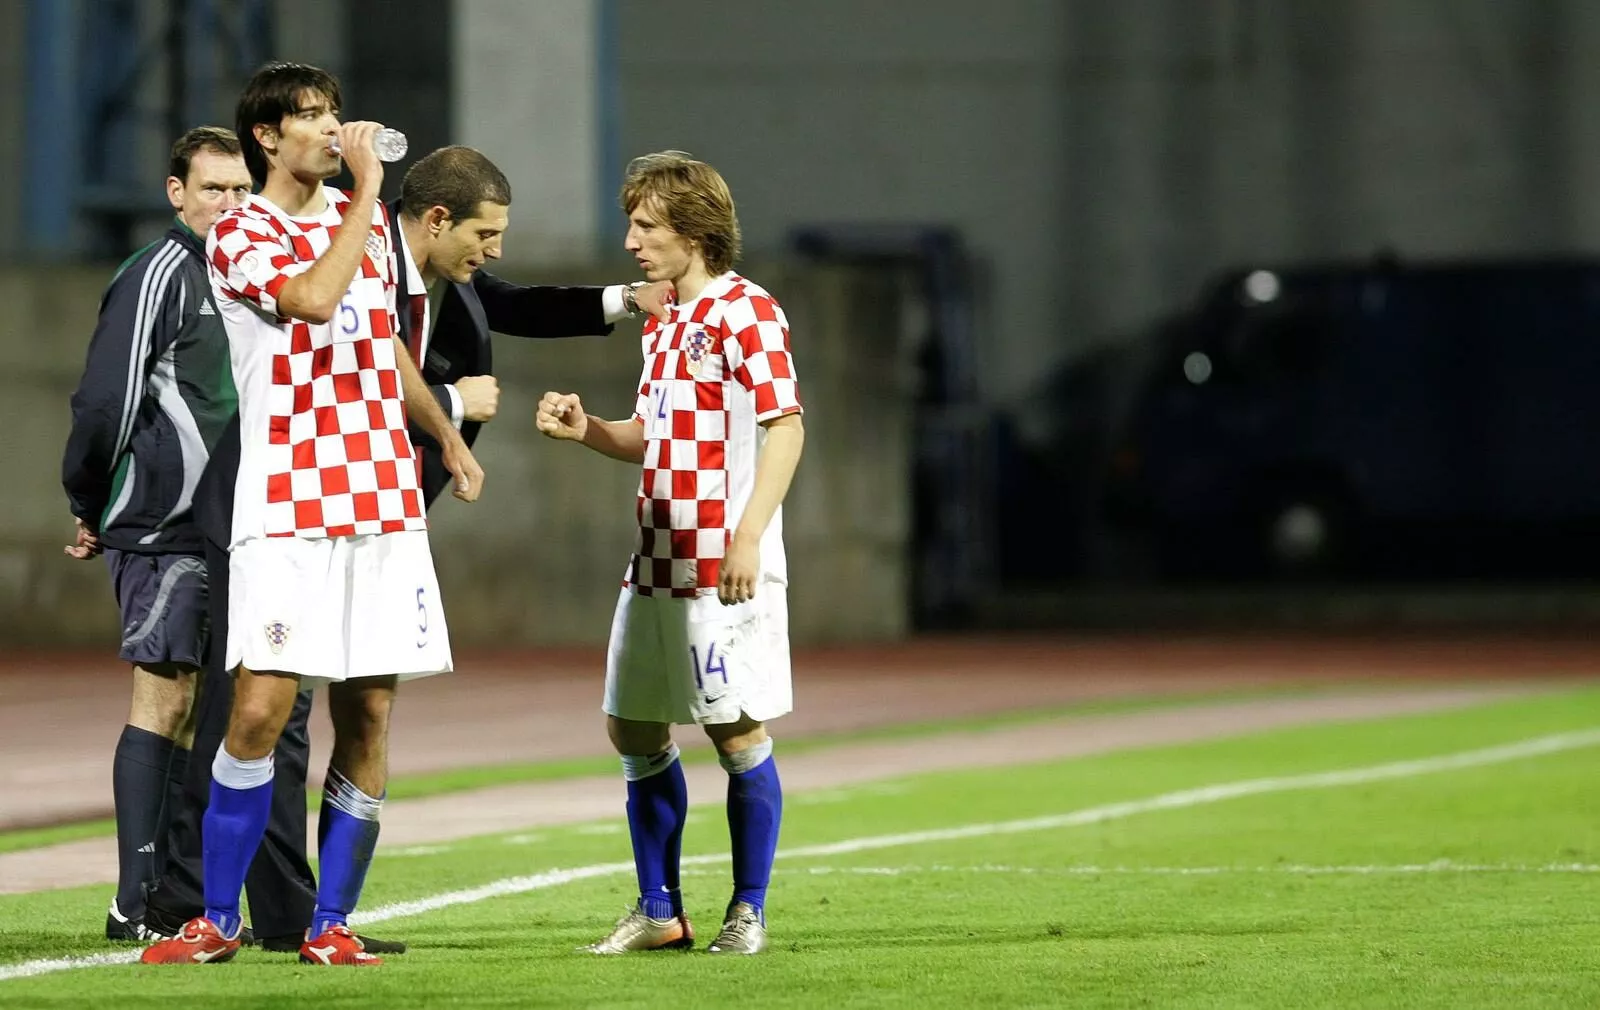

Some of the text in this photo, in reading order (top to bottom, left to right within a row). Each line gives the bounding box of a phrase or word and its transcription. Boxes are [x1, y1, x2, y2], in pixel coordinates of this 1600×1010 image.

[340, 290, 359, 334] 5
[654, 387, 668, 419] 4
[416, 587, 428, 632] 5
[690, 642, 728, 689] 14
